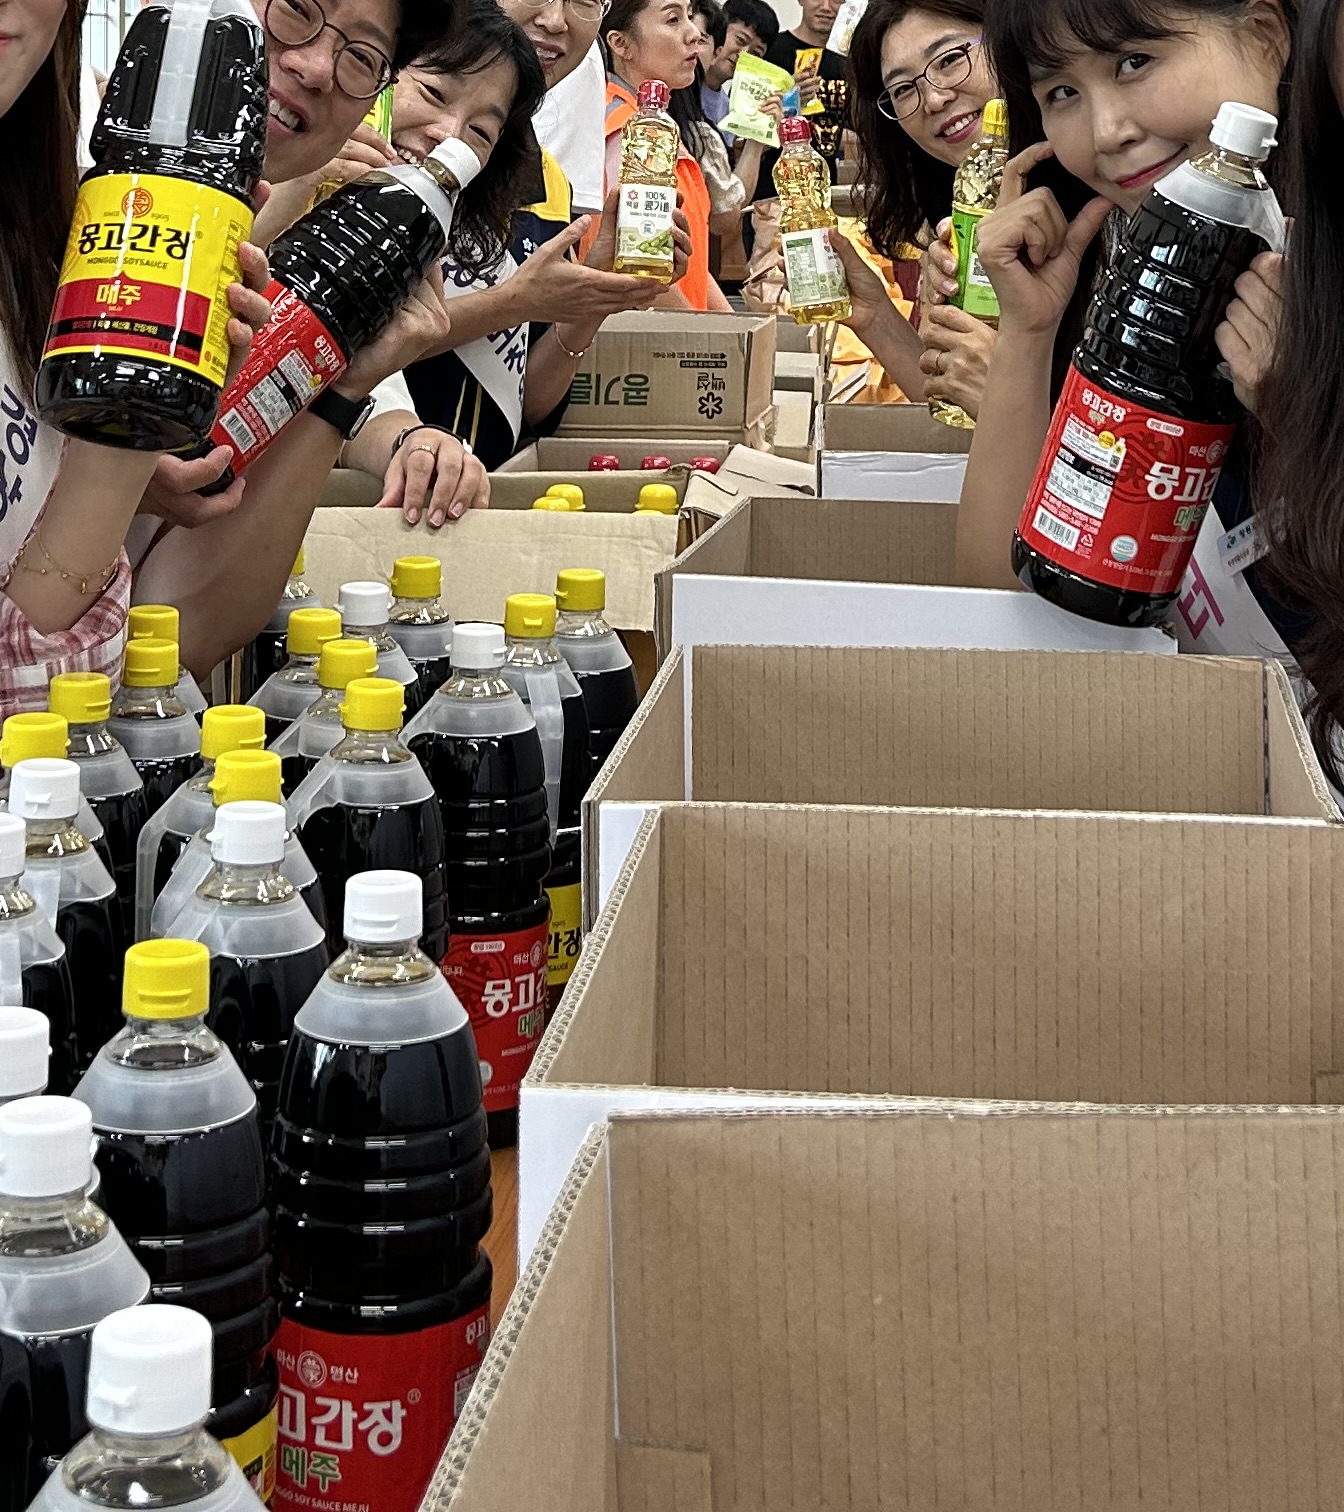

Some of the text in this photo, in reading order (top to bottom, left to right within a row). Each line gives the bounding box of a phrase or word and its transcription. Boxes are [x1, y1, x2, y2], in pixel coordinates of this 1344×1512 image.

[78, 222, 192, 261] 몽고간장
[95, 283, 142, 306] 메주
[569, 372, 651, 406] 콩기름
[1081, 387, 1127, 423] 몽고간장
[281, 1443, 342, 1493] 메주
